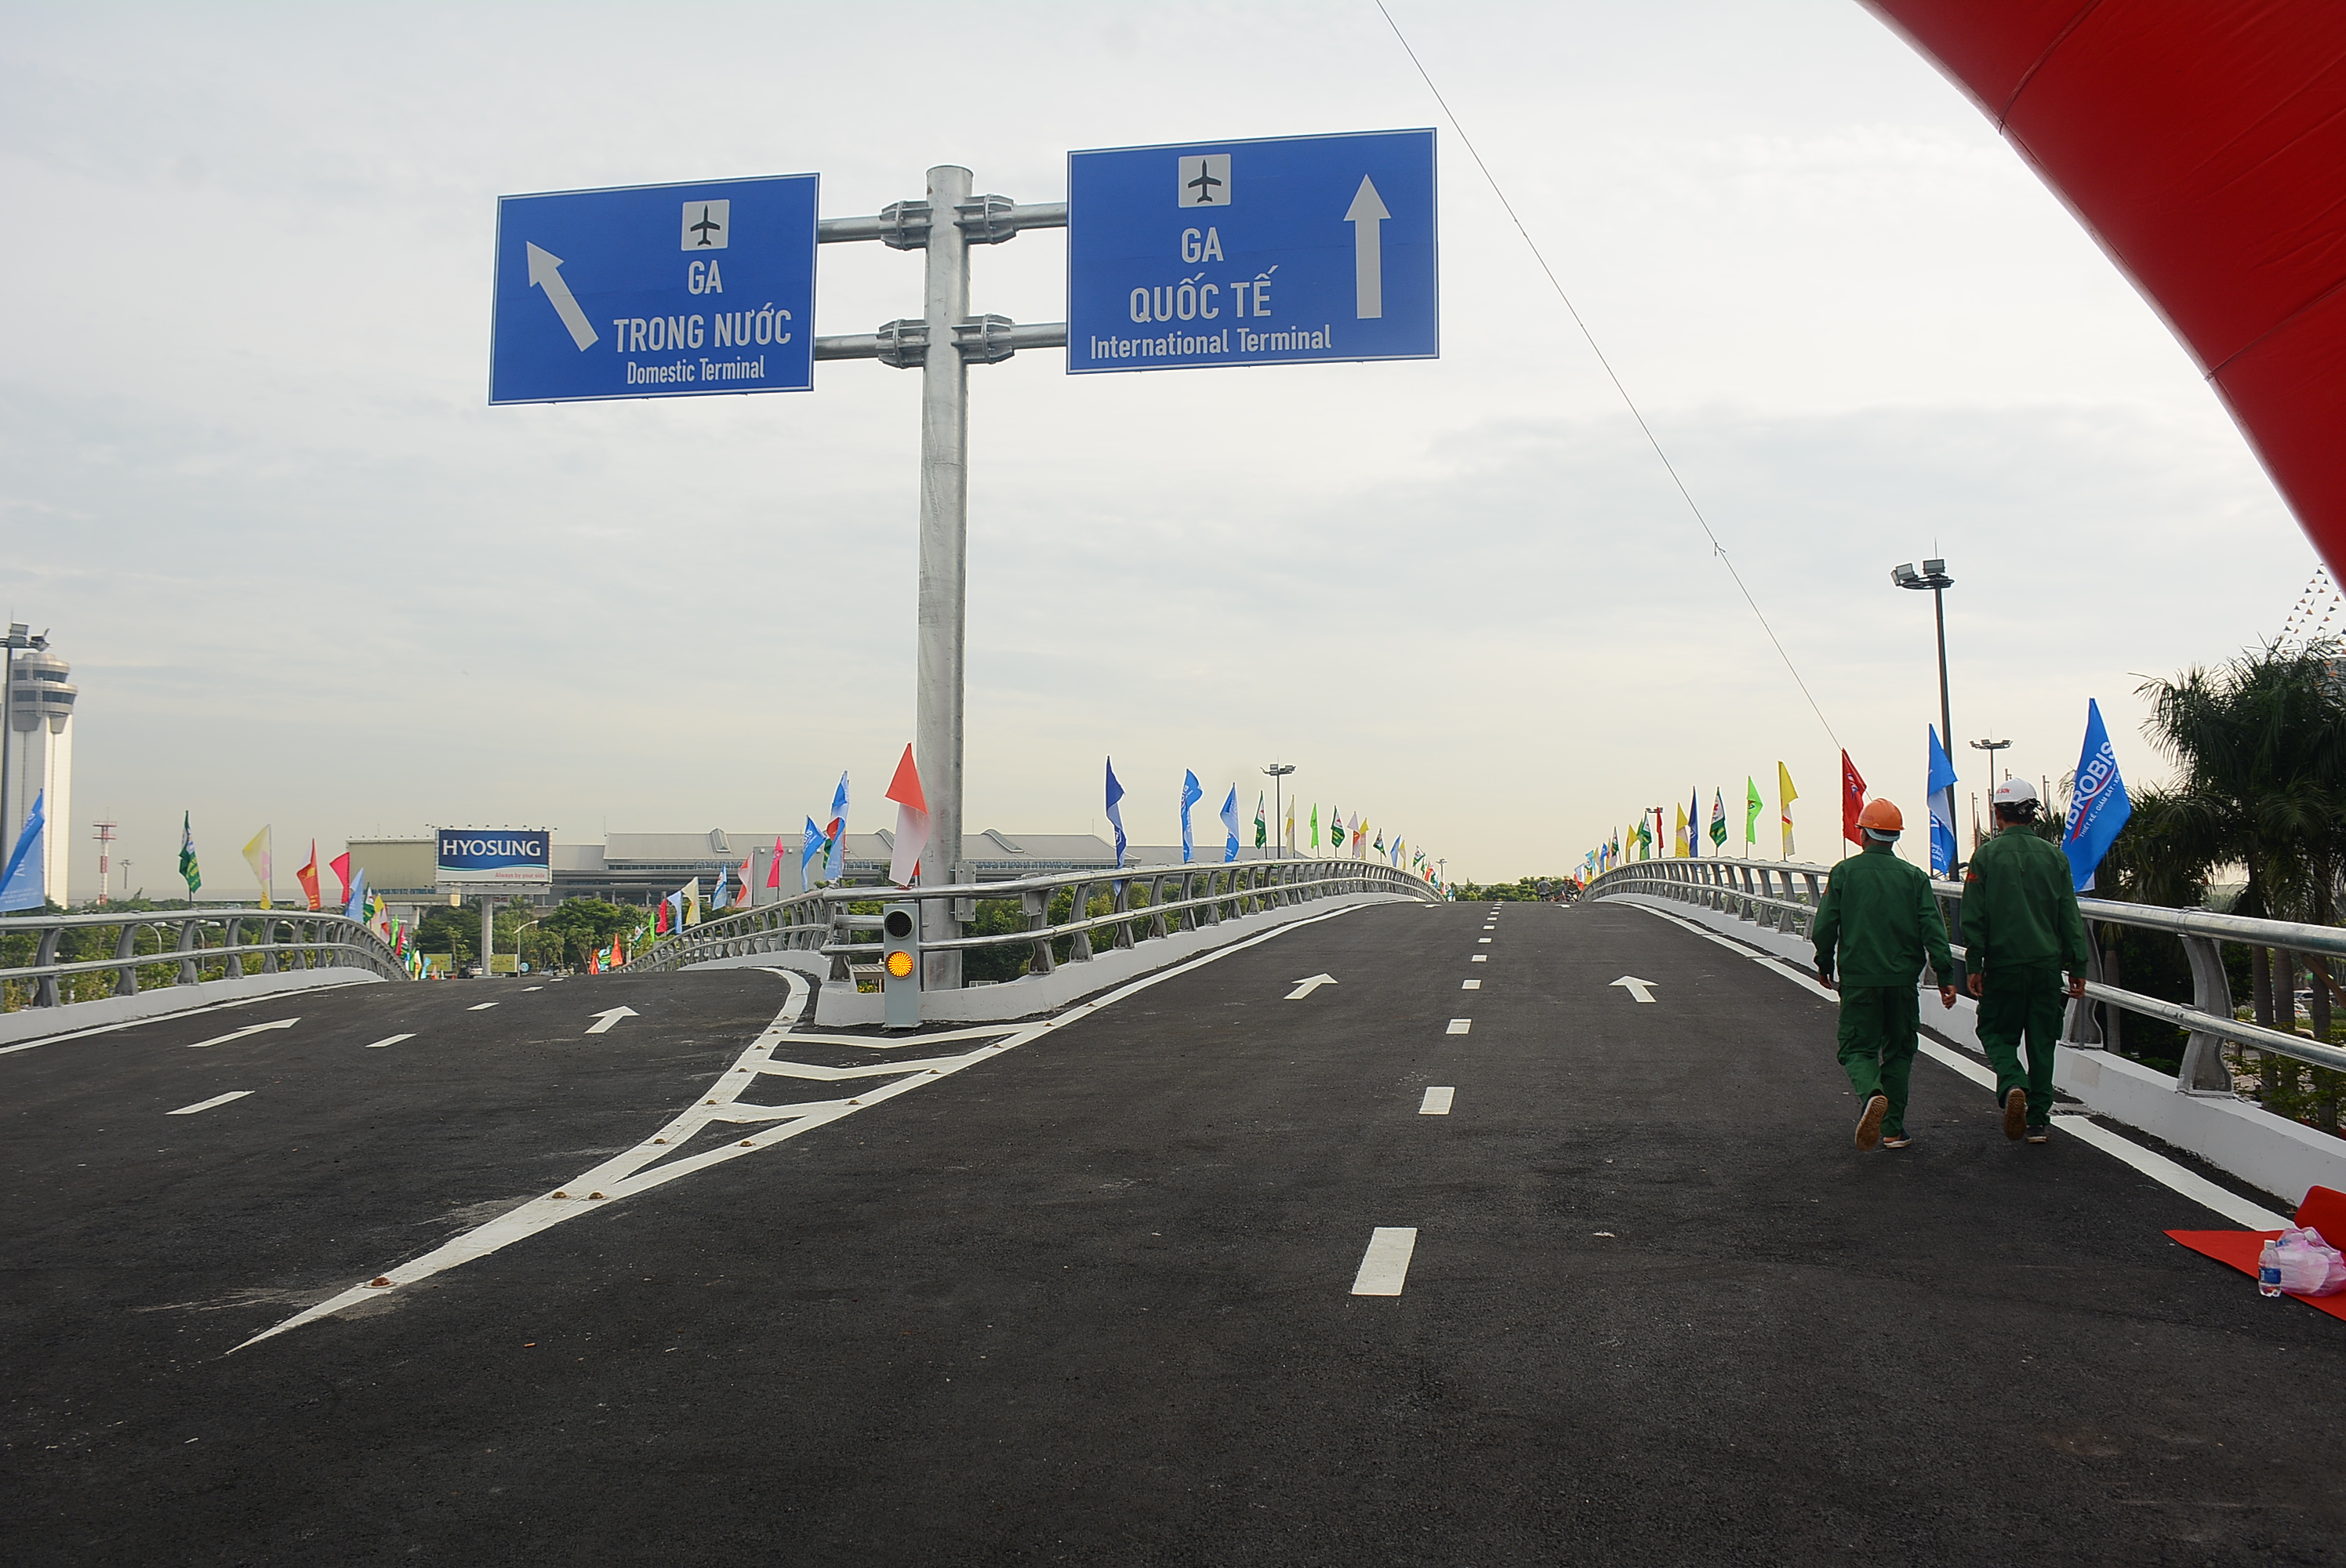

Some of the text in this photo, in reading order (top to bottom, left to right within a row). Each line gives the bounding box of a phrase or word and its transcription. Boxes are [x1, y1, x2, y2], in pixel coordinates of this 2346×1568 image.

[1182, 227, 1224, 263] GA
[688, 260, 723, 295] GA
[1130, 265, 1279, 323] QUỐC TẾ
[613, 302, 792, 353] TRONG NƯỚC
[1091, 324, 1331, 360] International Terminal
[626, 354, 764, 384] Domestic Terminal
[442, 839, 541, 857] HYOSUNG
